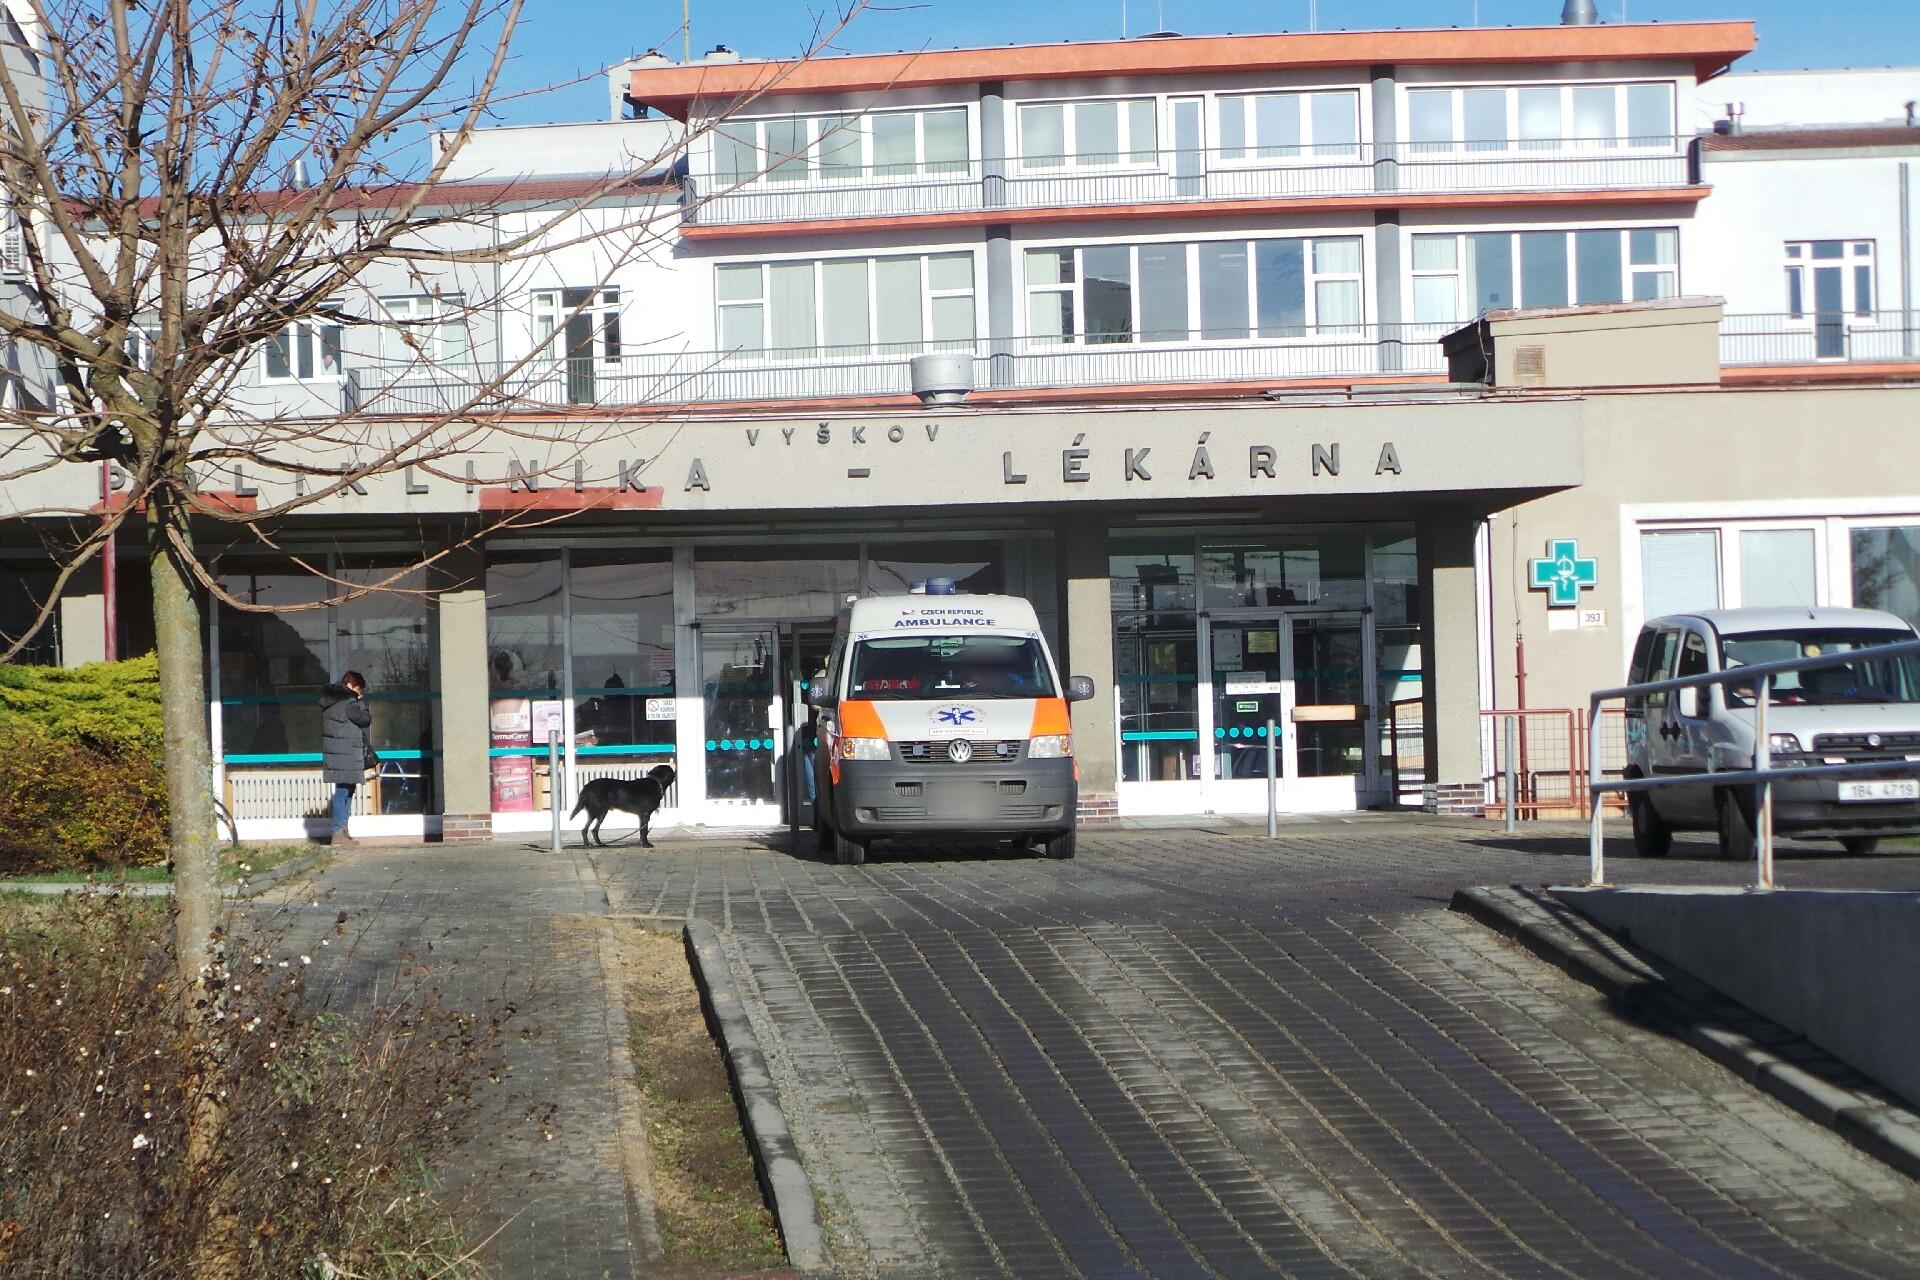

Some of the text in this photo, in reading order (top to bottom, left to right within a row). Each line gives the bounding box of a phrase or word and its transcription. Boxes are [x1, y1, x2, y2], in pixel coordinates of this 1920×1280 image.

[746, 422, 940, 447] VYŠKOV
[1003, 431, 1402, 485] LÉKÁRNA
[894, 618, 997, 628] AMBULANCE
[1584, 613, 1601, 623] 393
